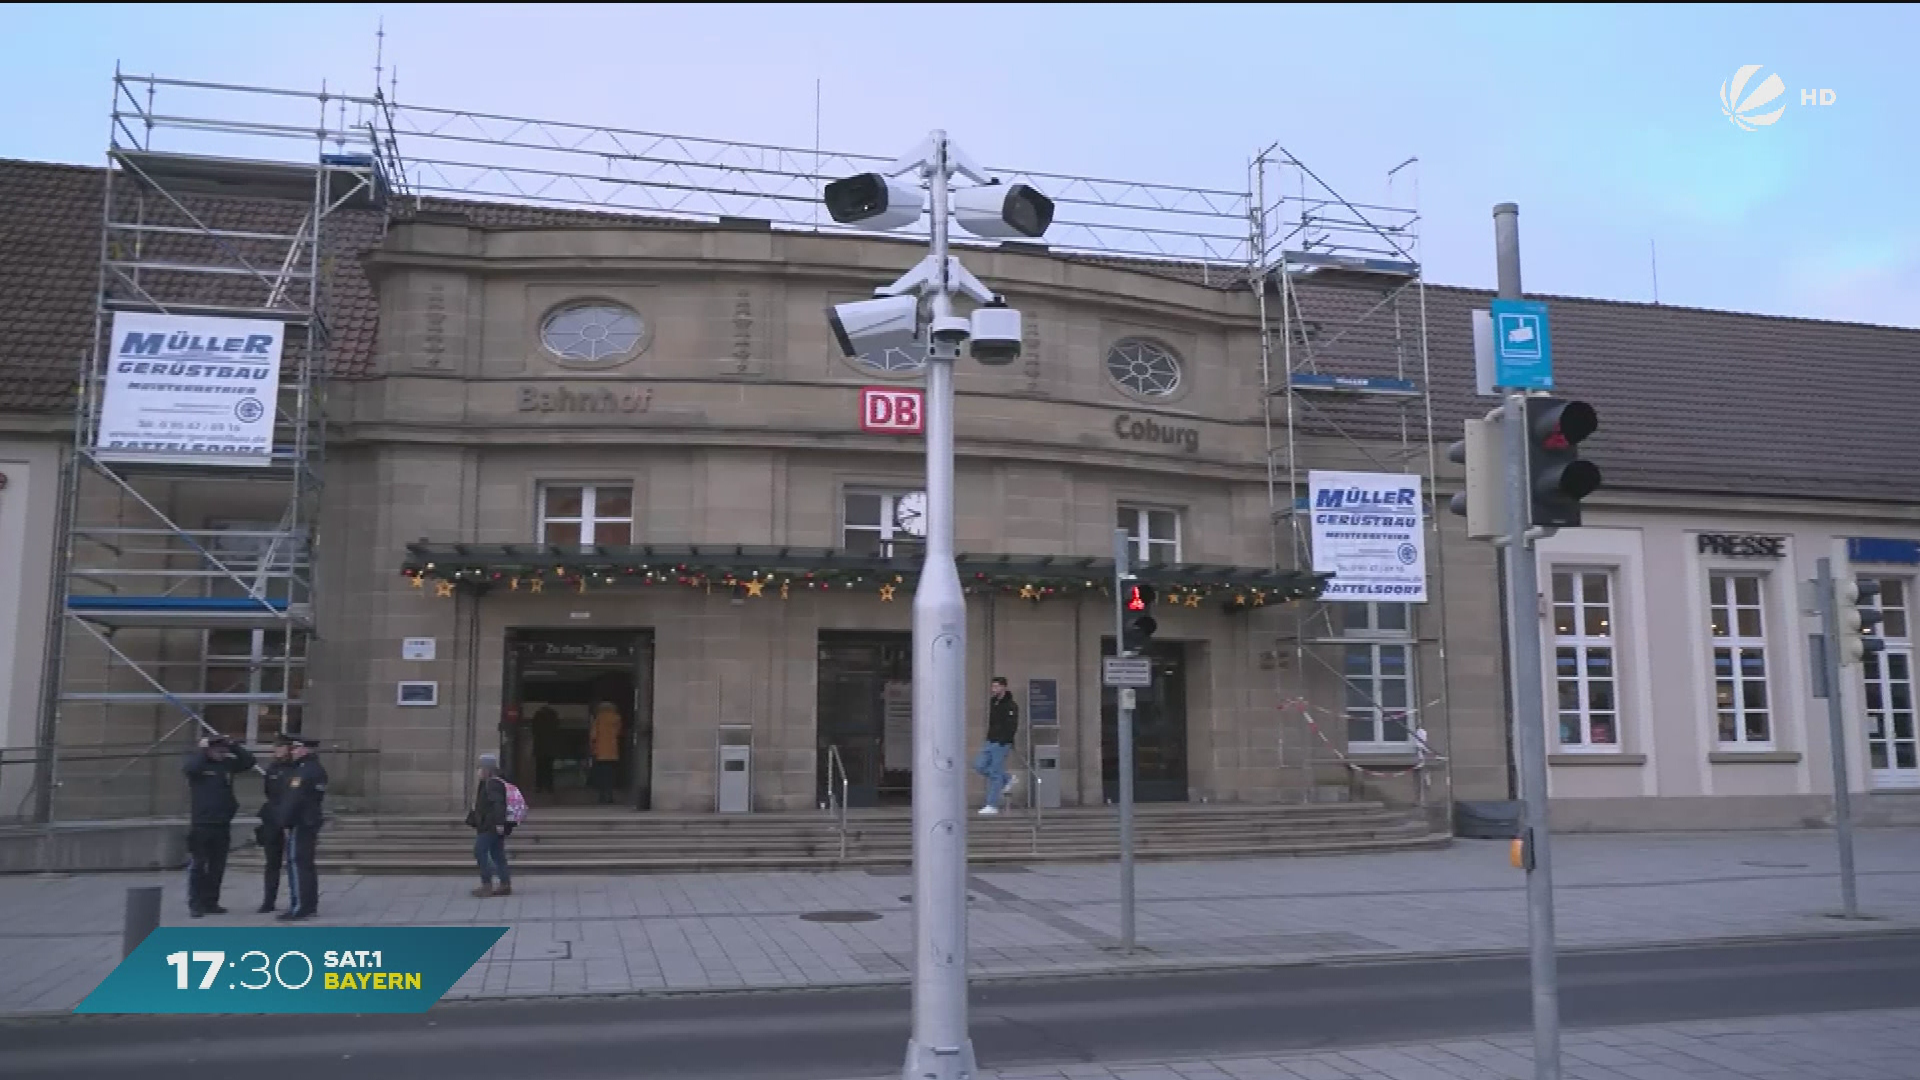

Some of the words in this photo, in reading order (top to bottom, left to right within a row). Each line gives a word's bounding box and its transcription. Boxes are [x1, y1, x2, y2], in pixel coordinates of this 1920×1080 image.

[120, 331, 273, 355] MÜLLER
[117, 361, 269, 380] GERÜSTBAU
[518, 386, 654, 413] Bahnhof
[868, 394, 918, 426] DB
[1114, 414, 1199, 451] Coburg
[1316, 486, 1416, 508] MÜLLER
[1316, 513, 1416, 528] GERÜSTBAU
[1698, 533, 1786, 558] PRESSE
